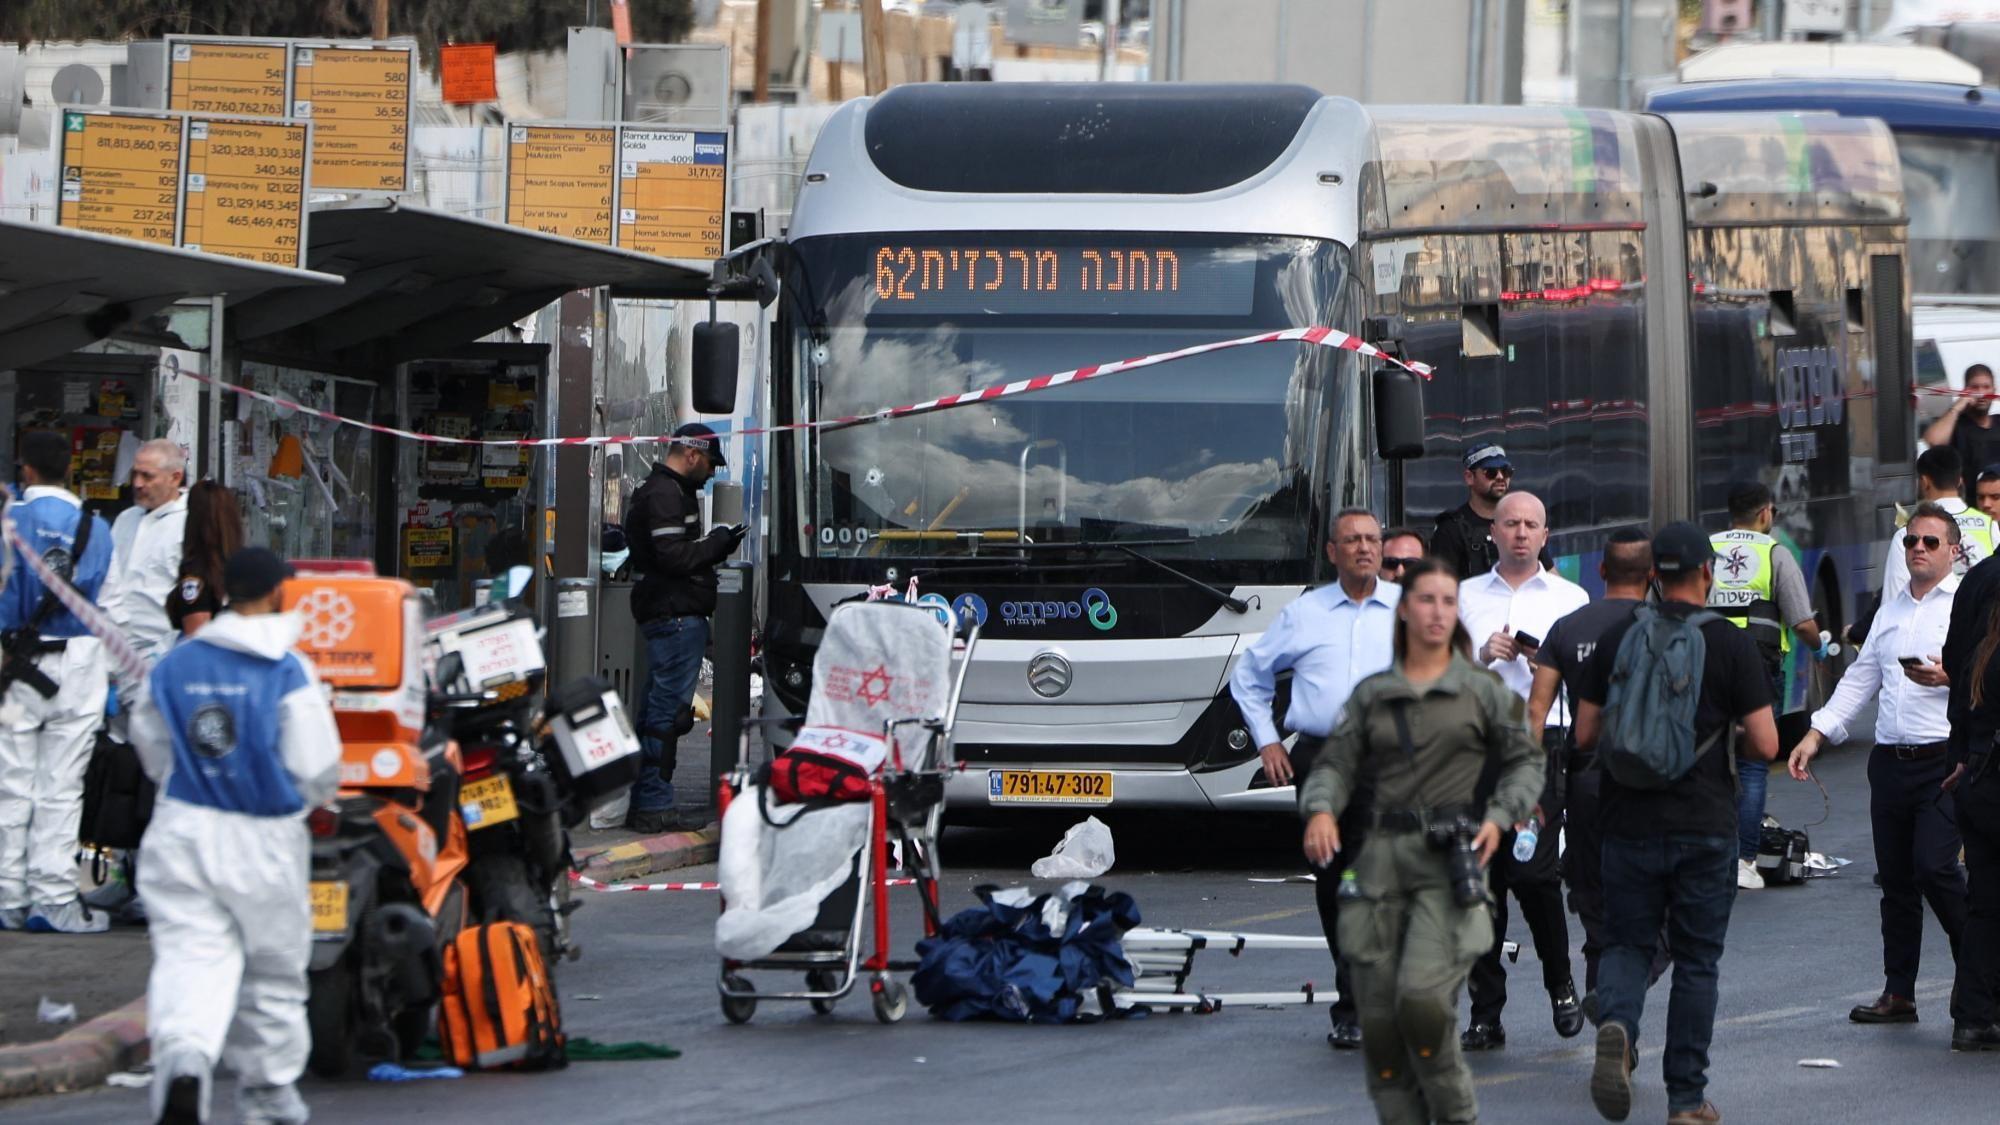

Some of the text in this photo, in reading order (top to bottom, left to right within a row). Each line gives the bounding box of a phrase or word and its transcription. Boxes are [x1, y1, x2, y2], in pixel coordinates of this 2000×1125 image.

[255, 52, 270, 60] ICC
[314, 53, 350, 63] Transport
[353, 54, 378, 63] Center
[265, 68, 284, 79] 541
[385, 72, 406, 82] 580
[220, 86, 259, 95] frequency
[262, 86, 283, 97] 756
[312, 89, 405, 100] Limited frequency 823
[192, 100, 282, 115] 757,760,762,763
[312, 106, 405, 118] Straus 36,56
[85, 121, 180, 134] Limited frequency 716
[391, 124, 404, 134] 36
[208, 128, 302, 141] Alighting Only 318
[527, 132, 551, 140] Ramat
[585, 133, 613, 144] 56,86
[623, 132, 687, 141] Ramot Junction/
[389, 141, 403, 152] 46
[528, 144, 586, 153] Transport Center
[622, 141, 646, 150] Golda
[210, 144, 302, 159] 320,328,330,338
[527, 152, 562, 160] HaArazim
[160, 158, 178, 169] 971
[671, 155, 694, 164] 4009
[254, 164, 300, 177] 340,348
[598, 164, 611, 174] 57
[687, 167, 723, 178] 31,71,72
[158, 175, 176, 187] 105
[526, 179, 547, 187] Mount
[549, 180, 574, 188] Scopus
[205, 180, 299, 194] Alighting Only 121,122
[217, 197, 298, 212] 123,129,145,345
[601, 196, 610, 205] 61
[227, 215, 297, 230] 465,469,475
[709, 215, 721, 225] 62
[115, 227, 133, 237] Only
[635, 229, 721, 241] Homat Schmuel 506
[275, 235, 296, 246] 479
[704, 246, 720, 256] 516
[876, 246, 1178, 300] תחנה מרכזית 62
[1726, 532, 1754, 541] חובש
[1000, 601, 1082, 619] סופרבוס
